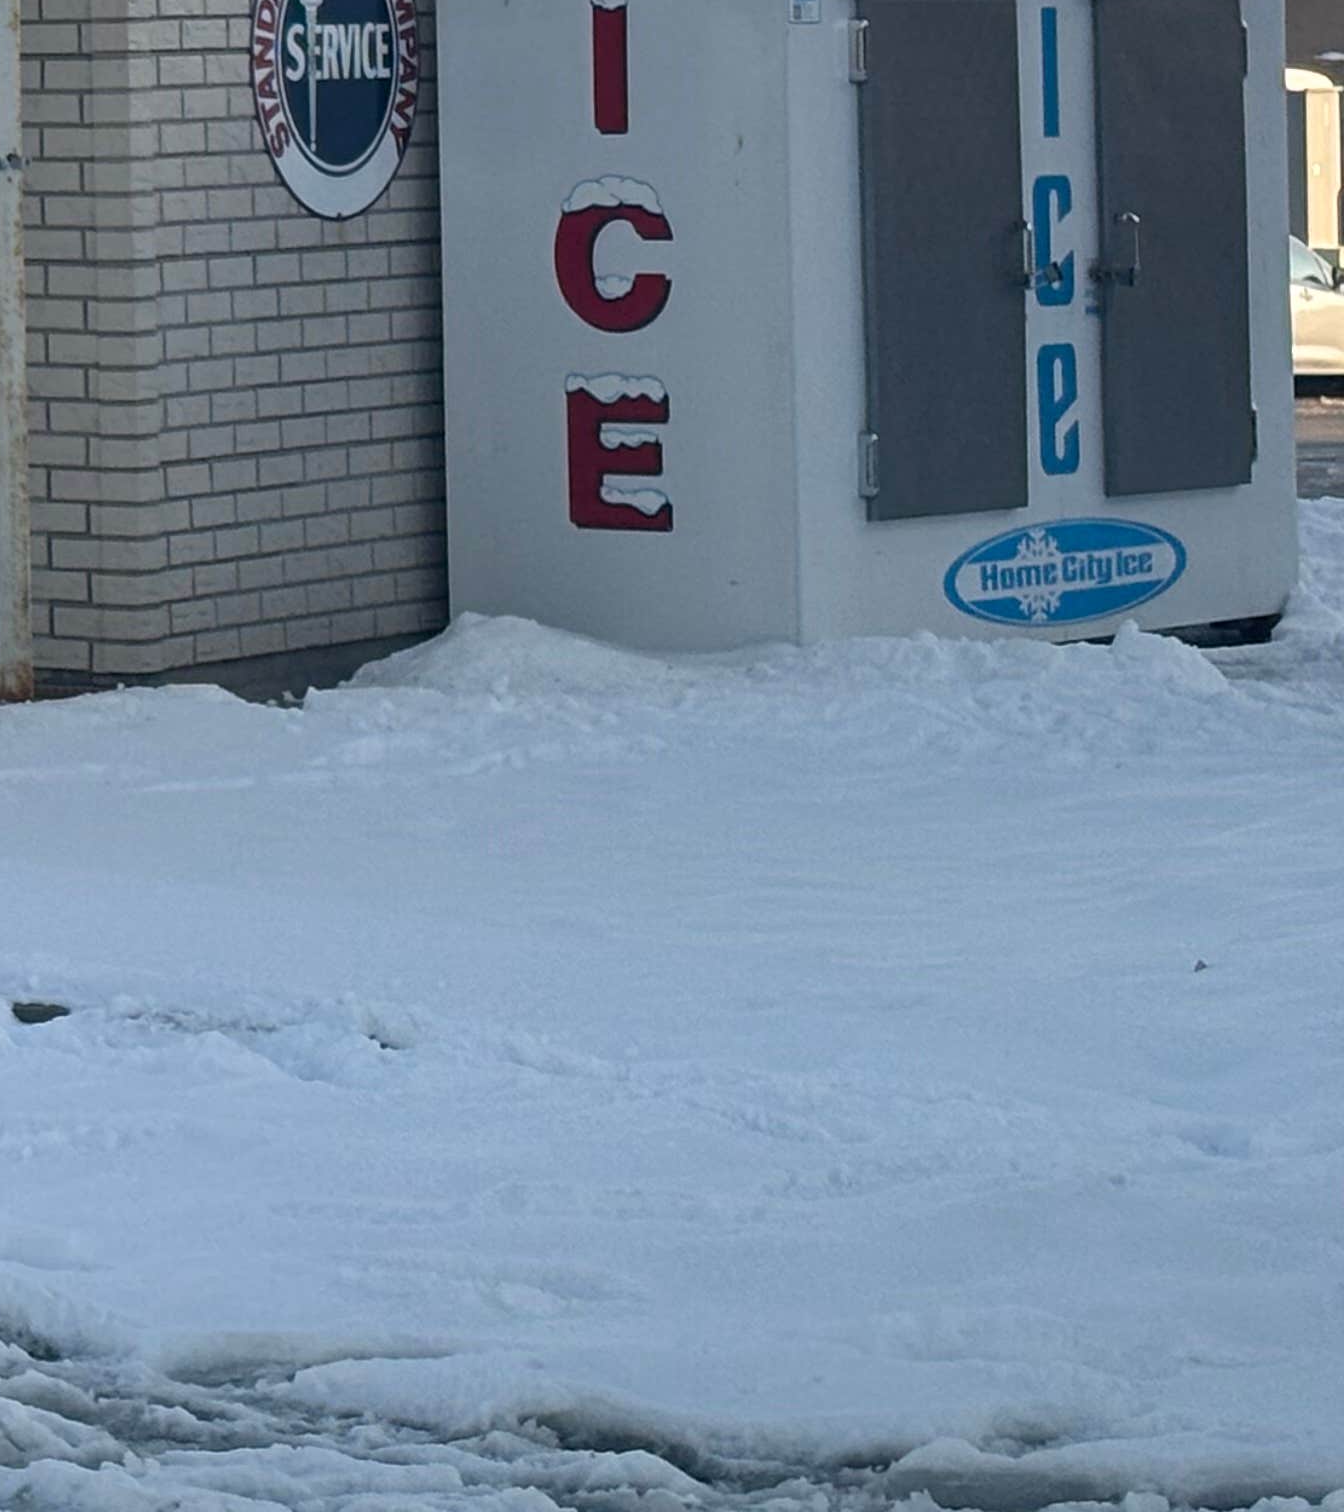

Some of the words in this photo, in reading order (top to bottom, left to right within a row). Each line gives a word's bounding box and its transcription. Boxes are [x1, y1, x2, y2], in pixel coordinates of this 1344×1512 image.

[286, 21, 392, 83] SERVICE
[981, 562, 1057, 592] Home
[1062, 554, 1114, 585] City
[1116, 551, 1154, 576] Ice
